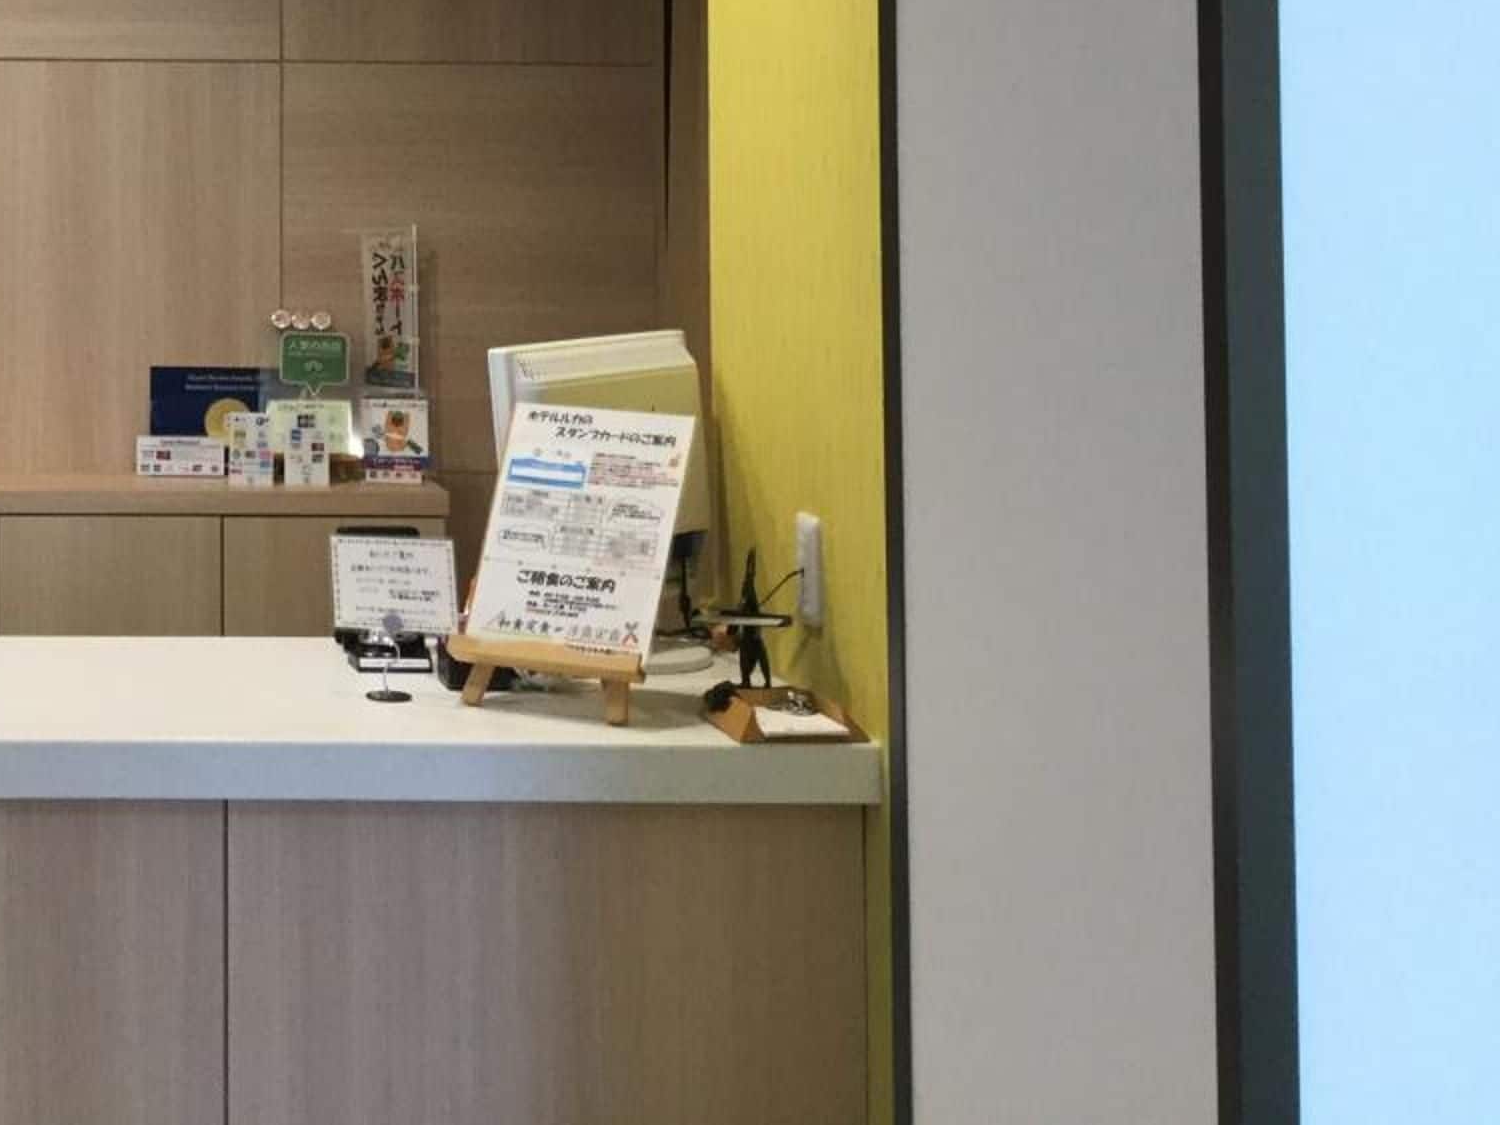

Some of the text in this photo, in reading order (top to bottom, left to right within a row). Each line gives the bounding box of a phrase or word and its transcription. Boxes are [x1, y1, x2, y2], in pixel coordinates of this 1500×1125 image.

[528, 409, 594, 426] ホテルルカの
